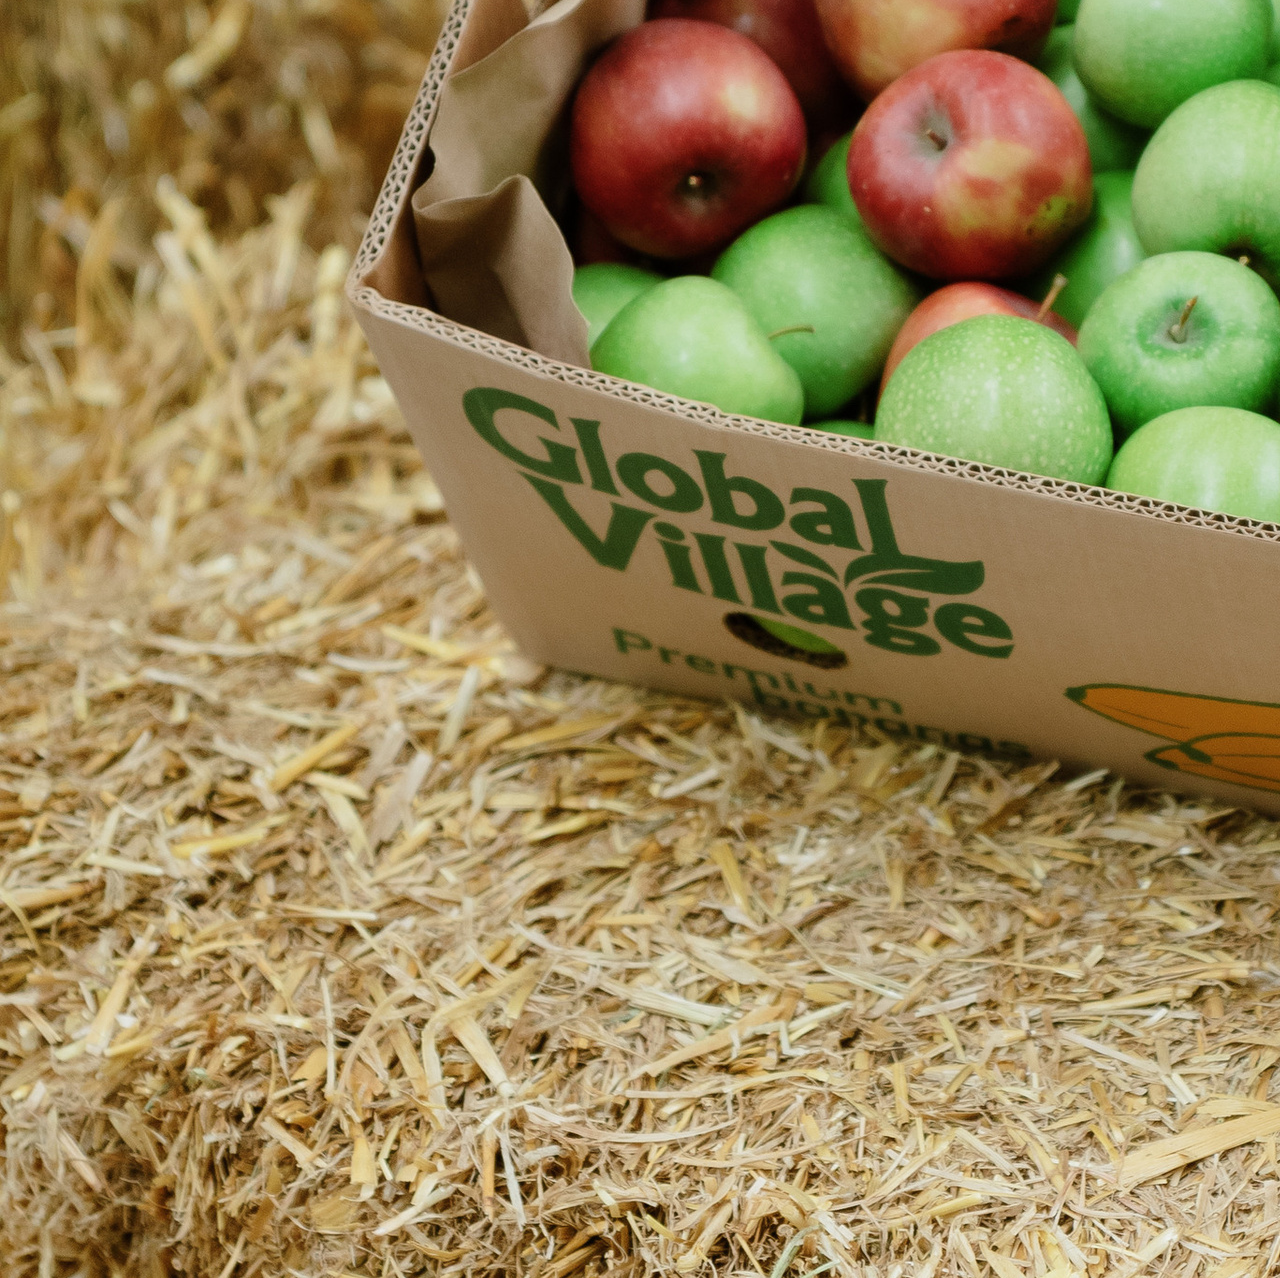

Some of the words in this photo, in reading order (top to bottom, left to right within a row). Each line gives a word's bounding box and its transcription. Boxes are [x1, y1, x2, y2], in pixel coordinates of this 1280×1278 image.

[462, 386, 985, 595] Global
[519, 470, 1014, 659] Village
[612, 627, 902, 715] Premium
[750, 672, 1032, 762] bananas
